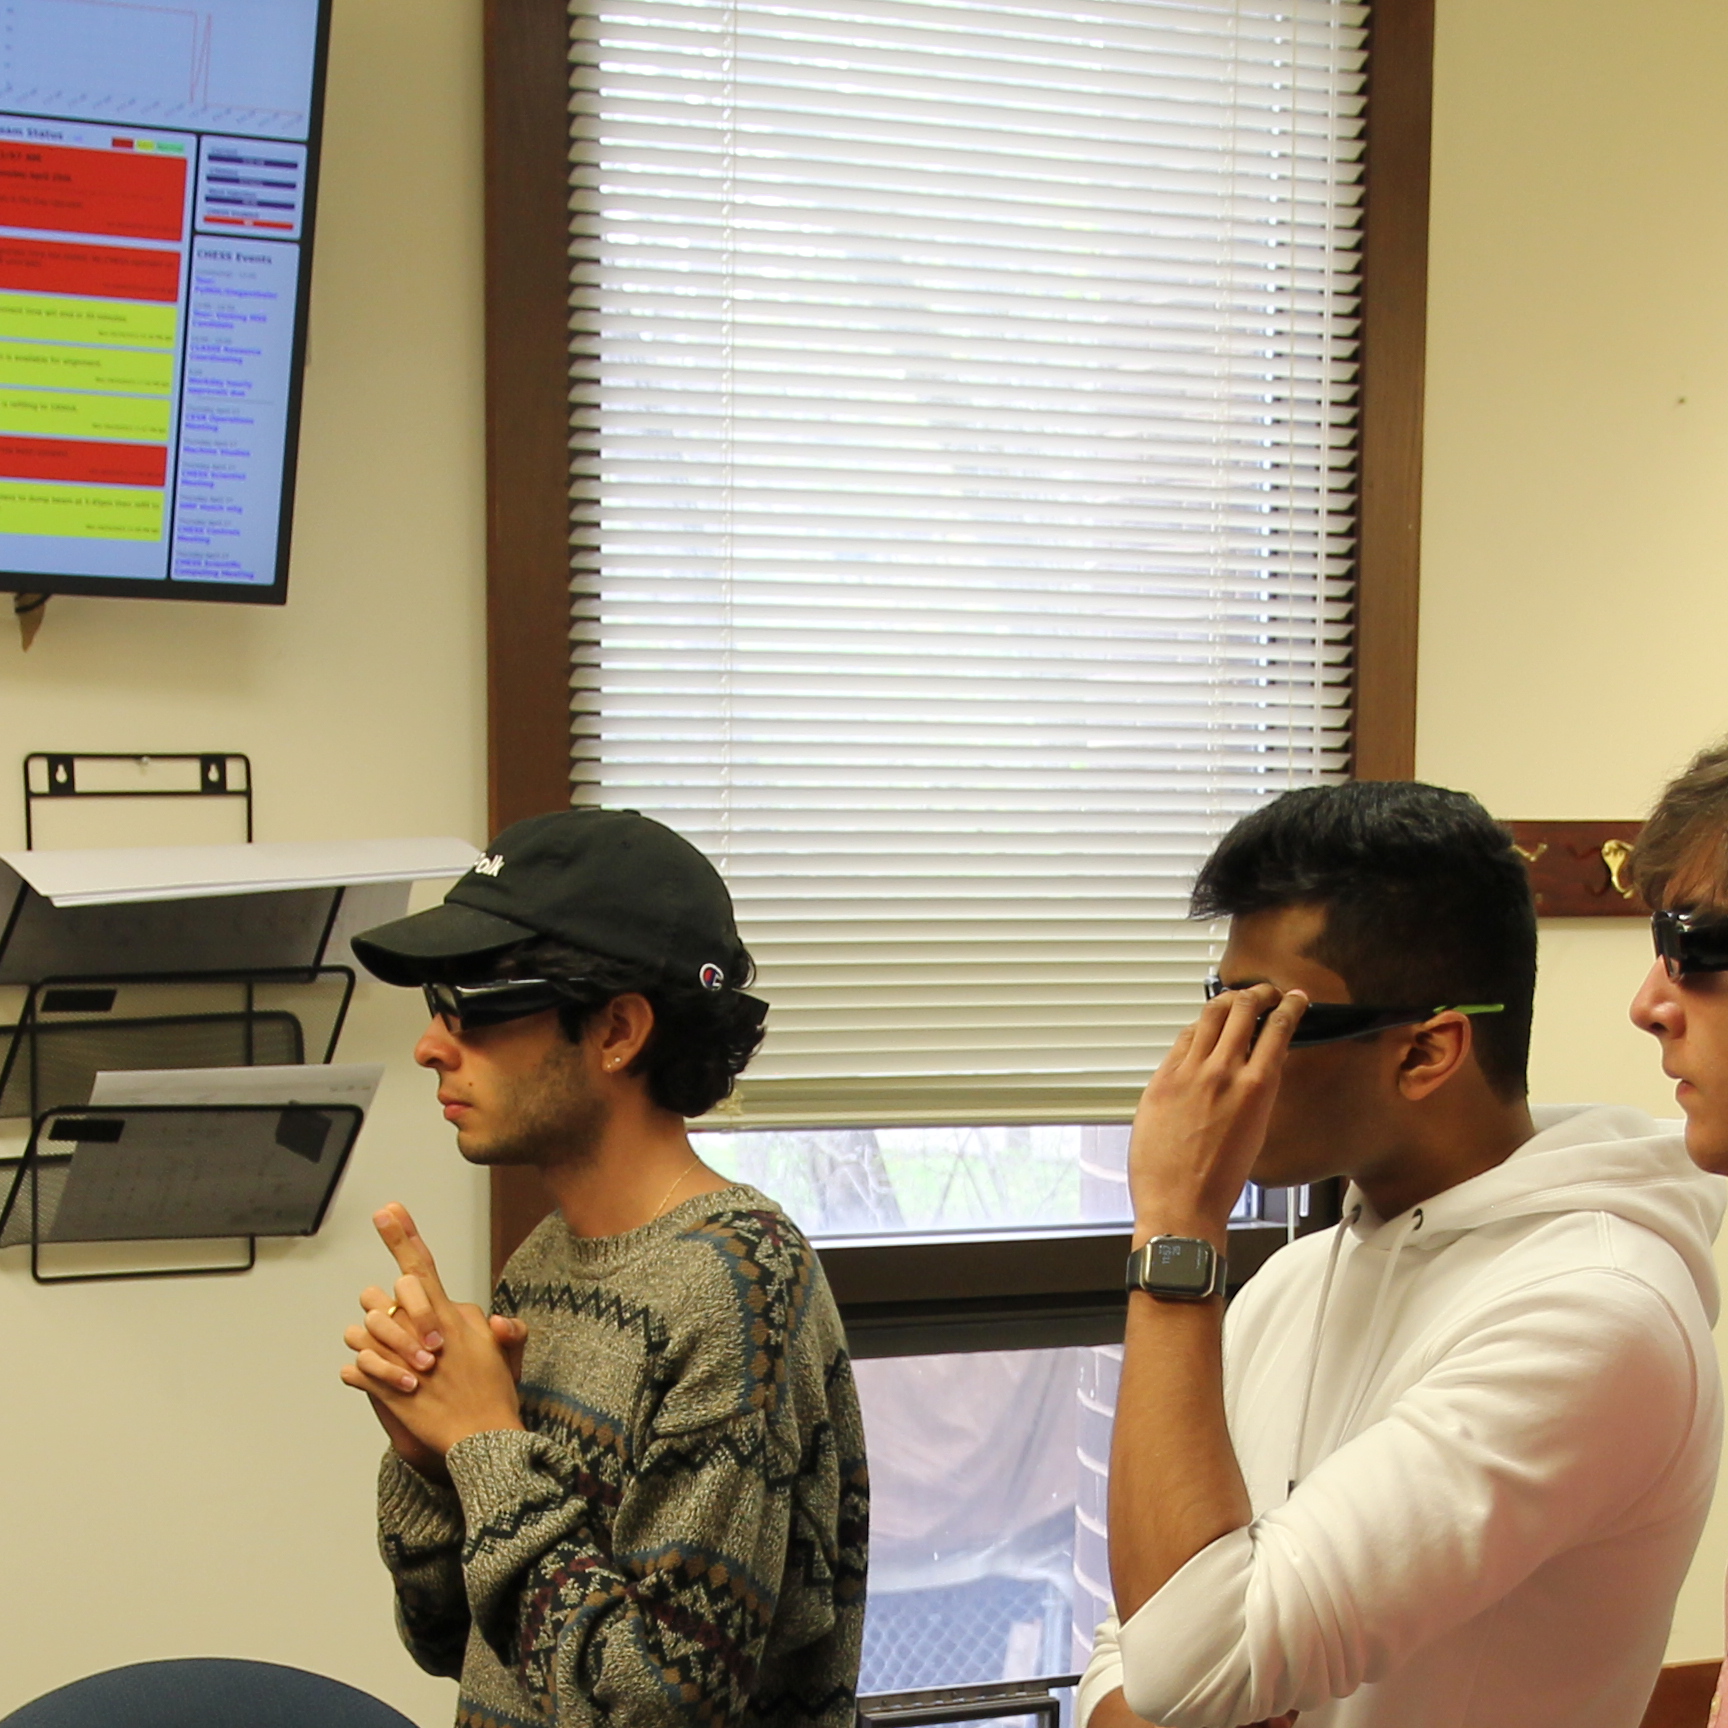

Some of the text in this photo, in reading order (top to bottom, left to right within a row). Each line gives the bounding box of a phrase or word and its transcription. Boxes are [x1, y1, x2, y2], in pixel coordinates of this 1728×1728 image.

[27, 127, 64, 140] Status
[197, 250, 272, 265] CHESS Events
